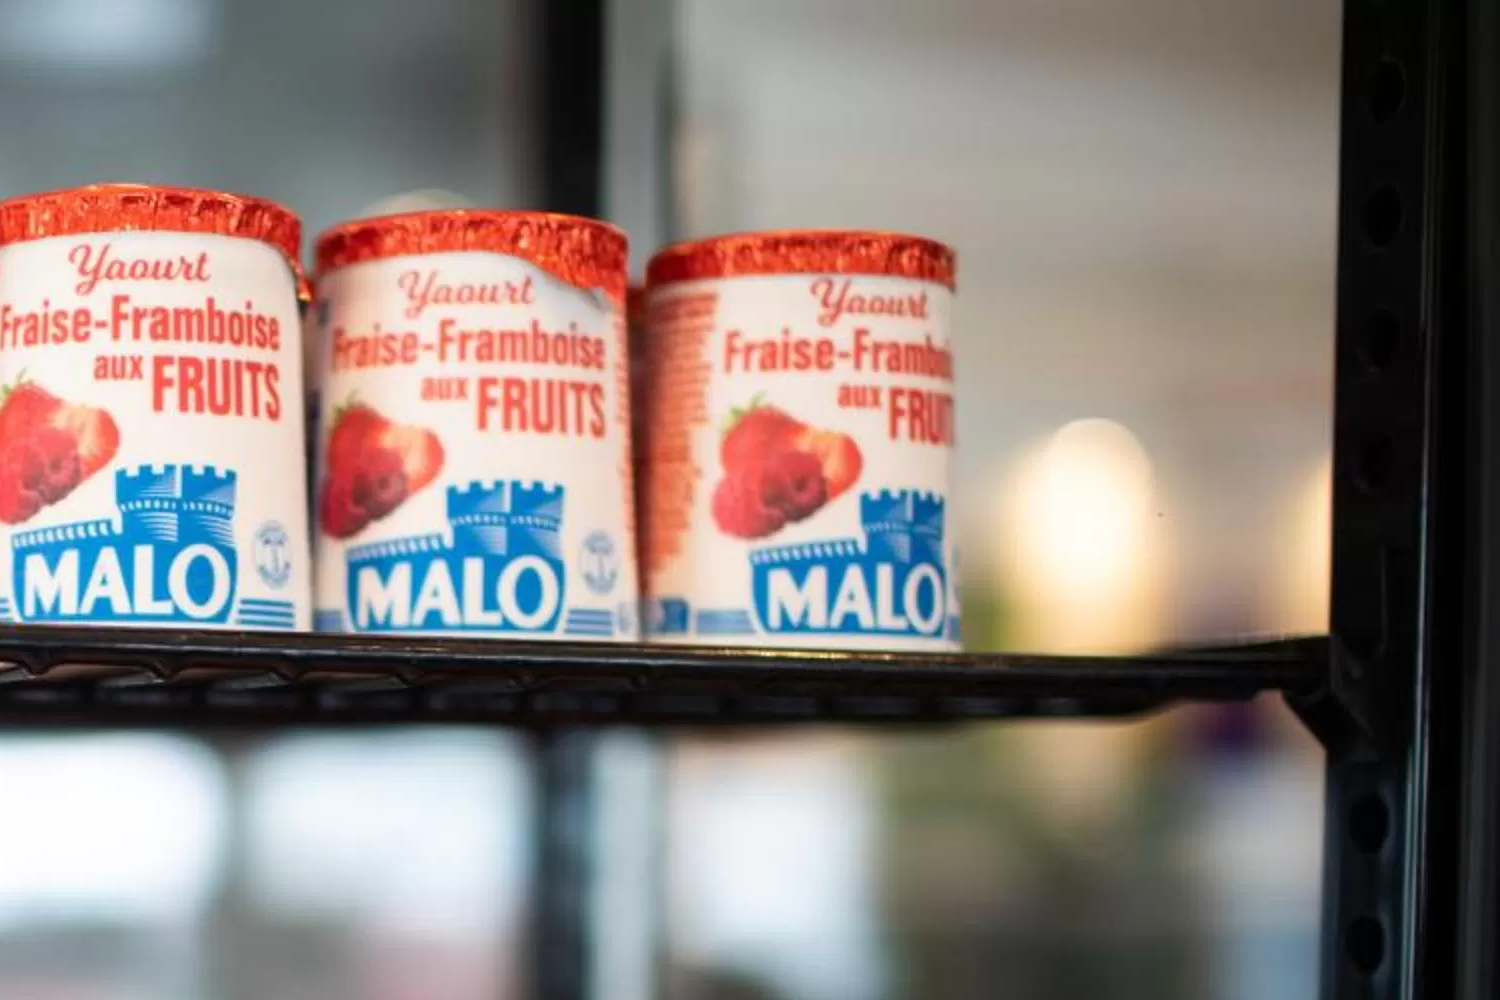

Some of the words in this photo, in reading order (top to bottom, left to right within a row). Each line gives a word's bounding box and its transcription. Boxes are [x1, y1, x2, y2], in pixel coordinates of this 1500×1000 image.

[68, 244, 210, 296] Yaourt
[398, 270, 536, 318] Yaourt
[0, 295, 279, 352] Fraise-Framboise
[332, 320, 604, 371] Fraise-Framboise
[93, 355, 143, 381] aux
[152, 356, 281, 422] FRUITS
[421, 378, 467, 402] aux
[477, 378, 605, 439] FRUITS
[25, 543, 230, 619] MALO
[356, 555, 558, 629] MALO
[767, 563, 945, 633] MALO
